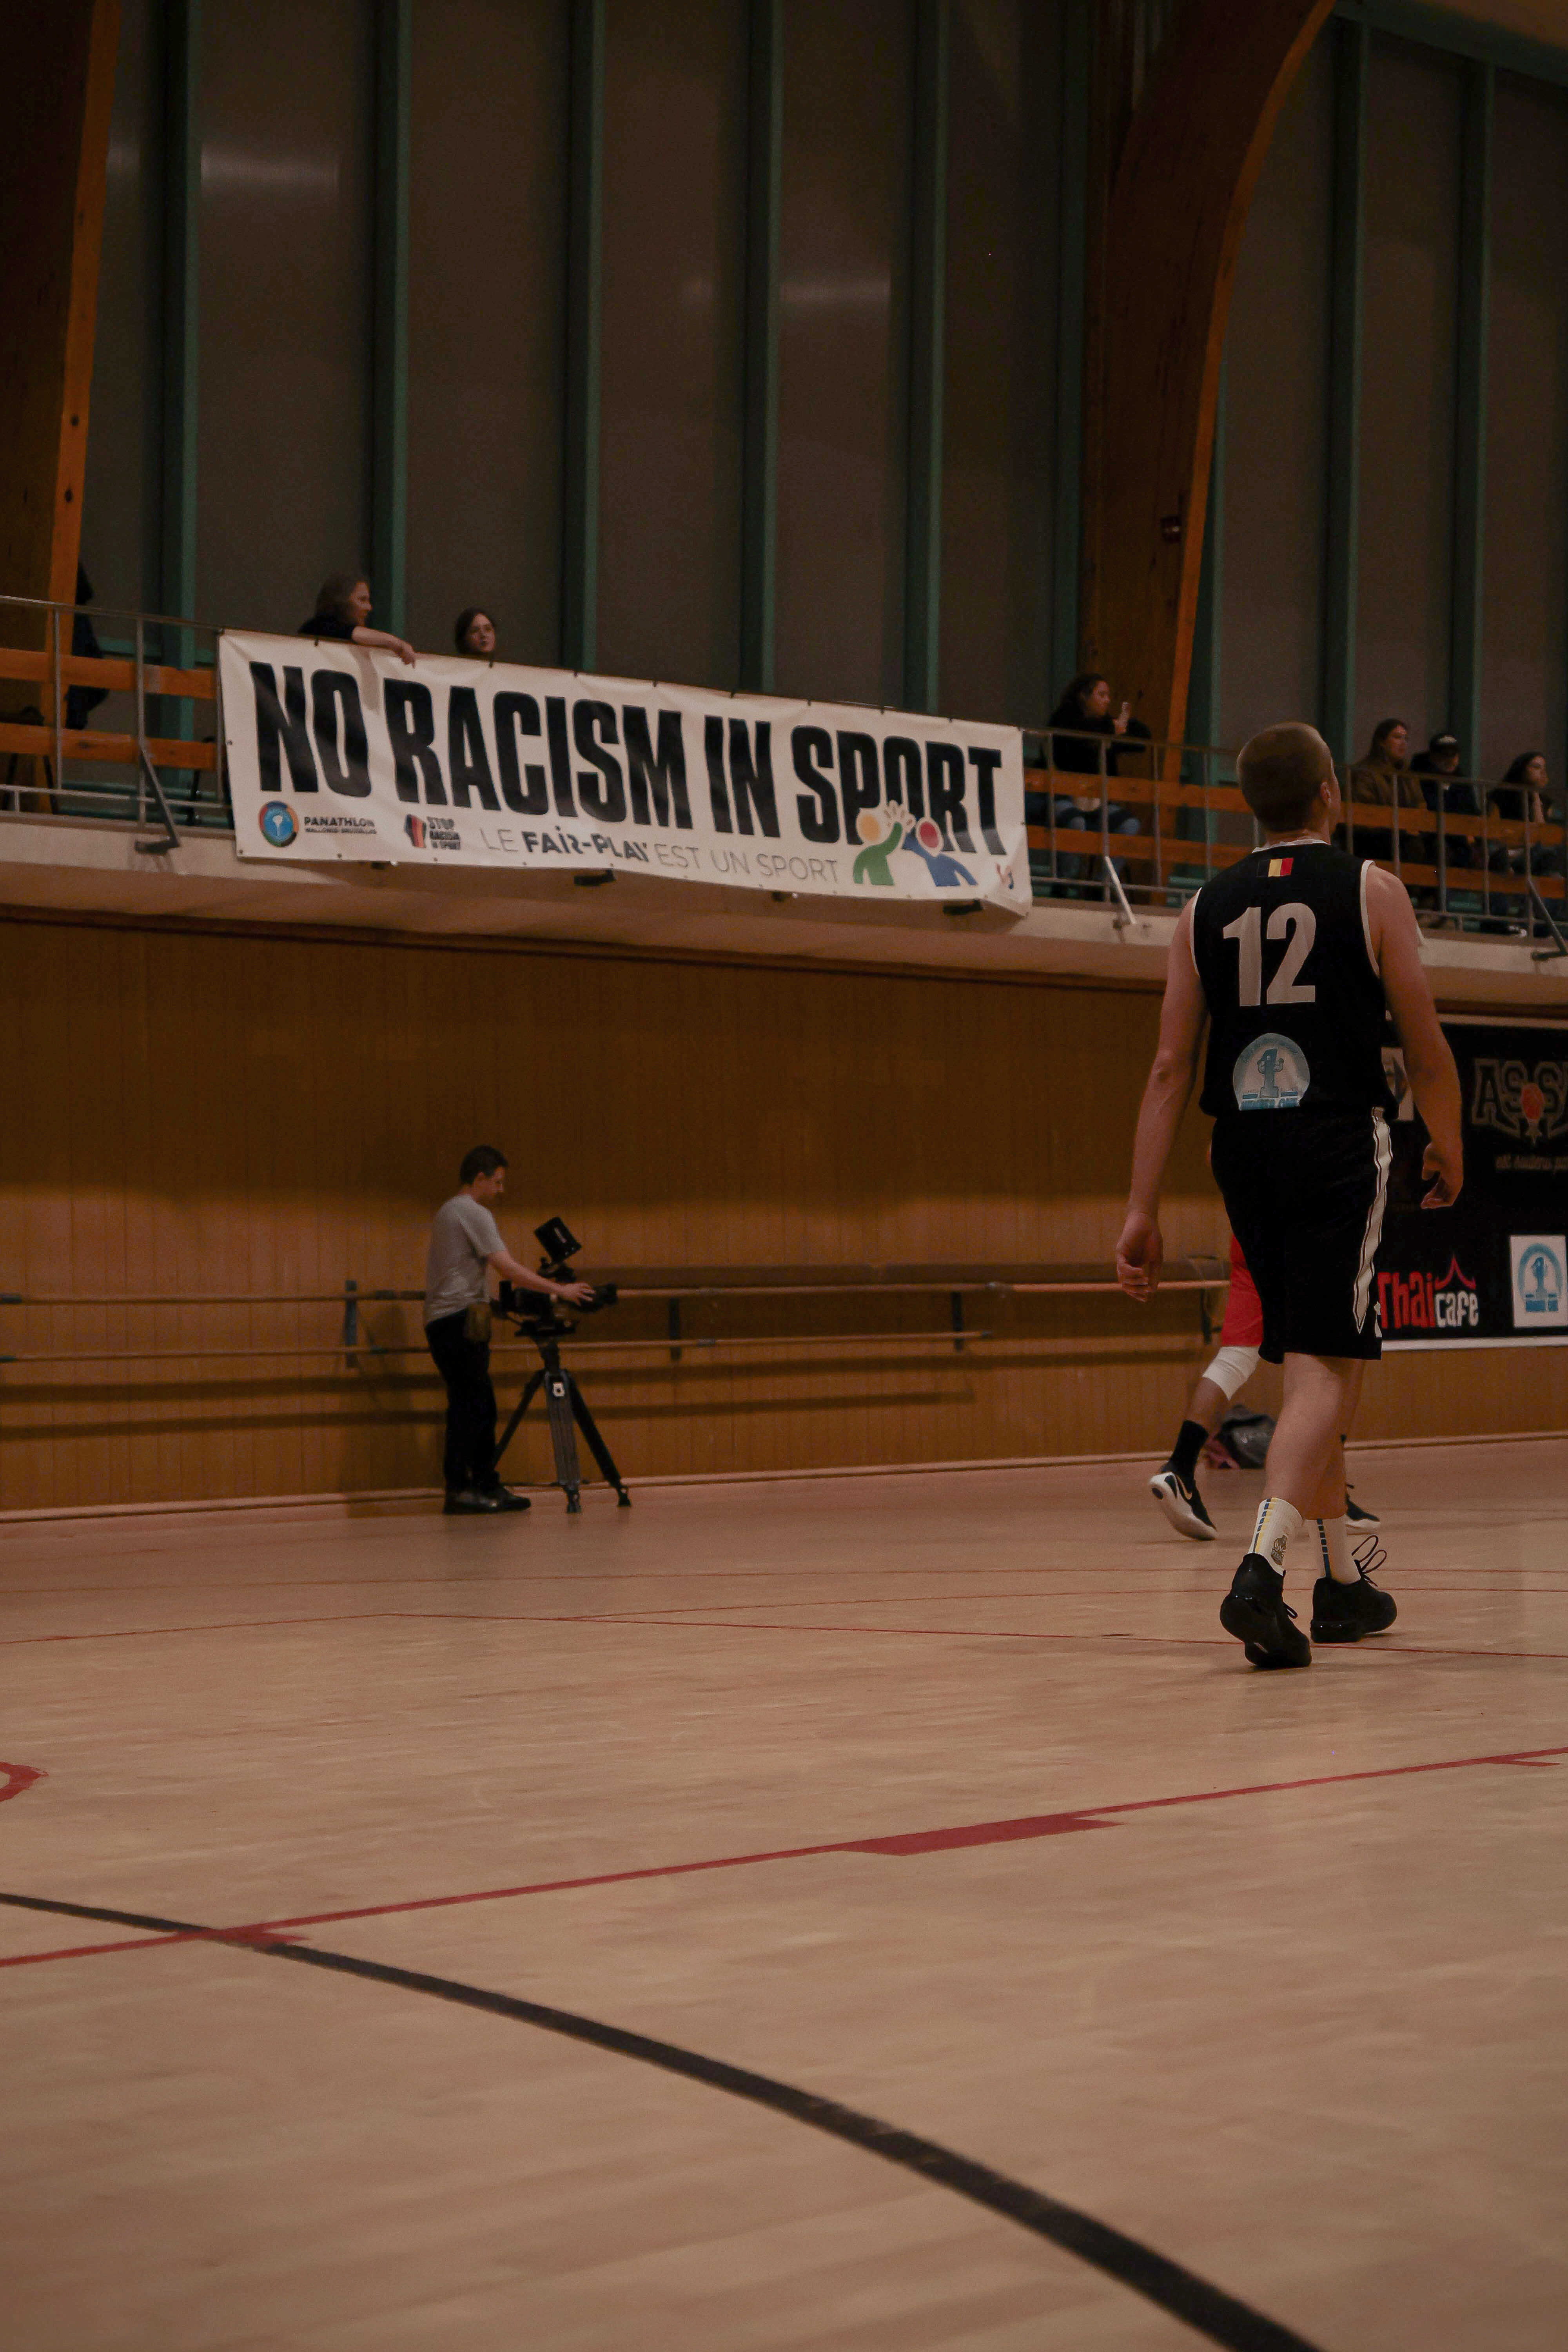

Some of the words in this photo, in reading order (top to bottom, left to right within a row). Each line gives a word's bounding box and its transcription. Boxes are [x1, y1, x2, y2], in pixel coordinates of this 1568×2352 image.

[250, 662, 371, 797] NO
[384, 678, 693, 829] RACISM
[704, 715, 780, 837] IN
[791, 726, 1006, 855] SPORT
[480, 828, 518, 852] LE
[654, 844, 701, 869] EST
[710, 849, 750, 874] UN
[756, 853, 838, 882] SPORT
[1222, 902, 1316, 1007] 12
[1471, 1058, 1568, 1126] ASS
[1377, 1271, 1436, 1328] Thai
